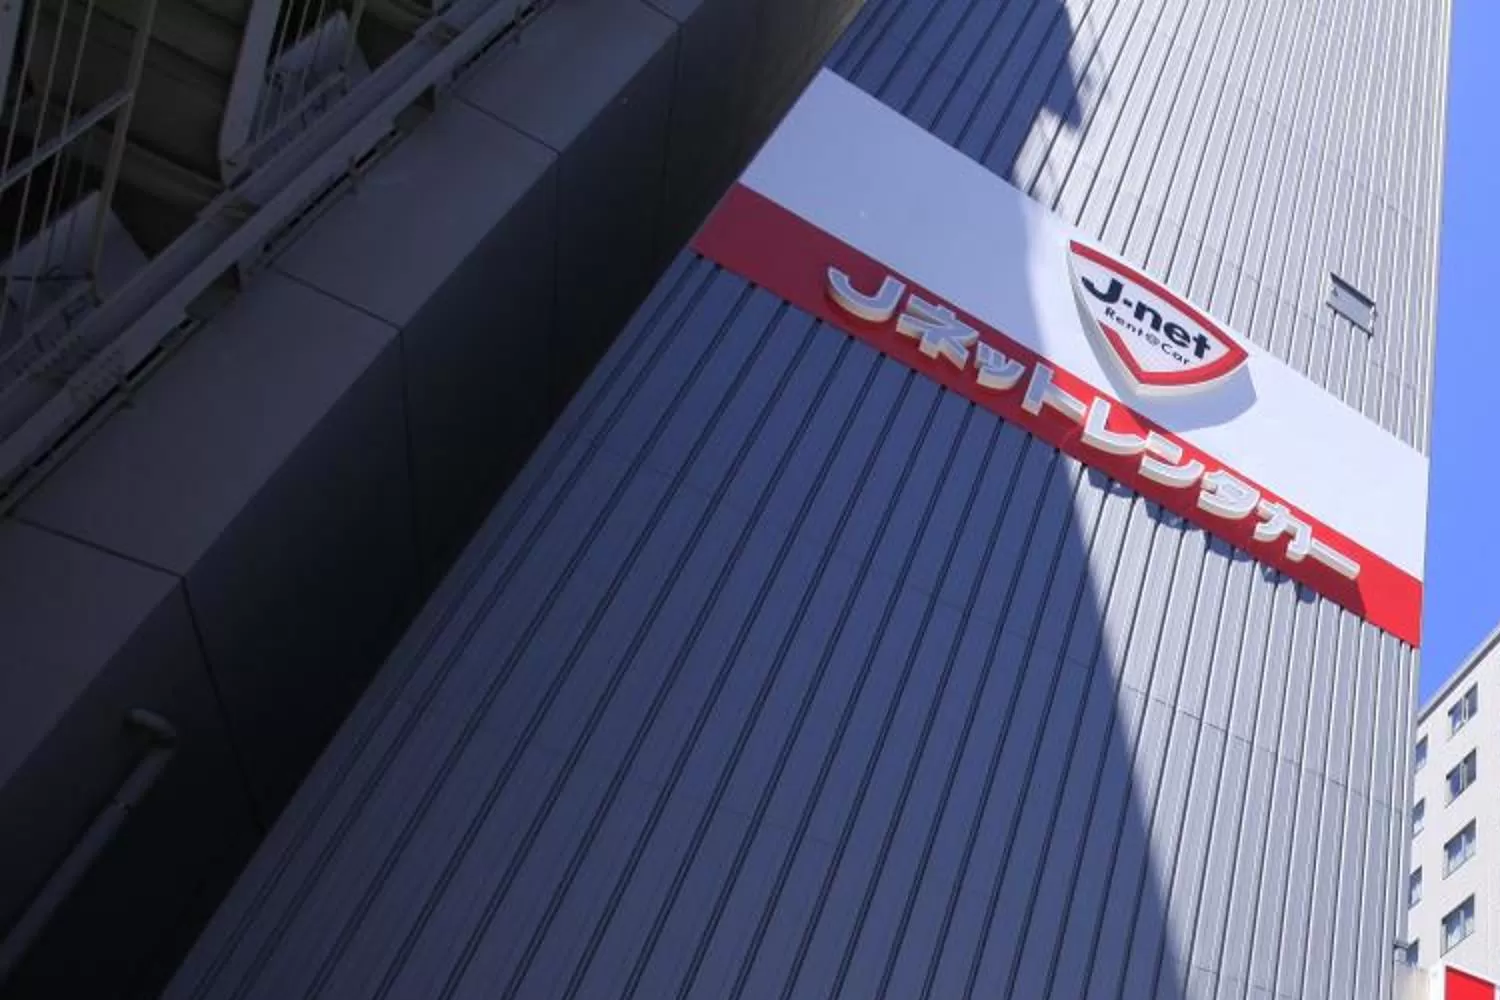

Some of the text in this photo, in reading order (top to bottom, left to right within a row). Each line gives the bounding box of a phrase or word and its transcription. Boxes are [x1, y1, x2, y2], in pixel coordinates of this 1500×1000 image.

[1081, 276, 1212, 359] J-net
[827, 266, 1361, 582] Jネットレンタカー
